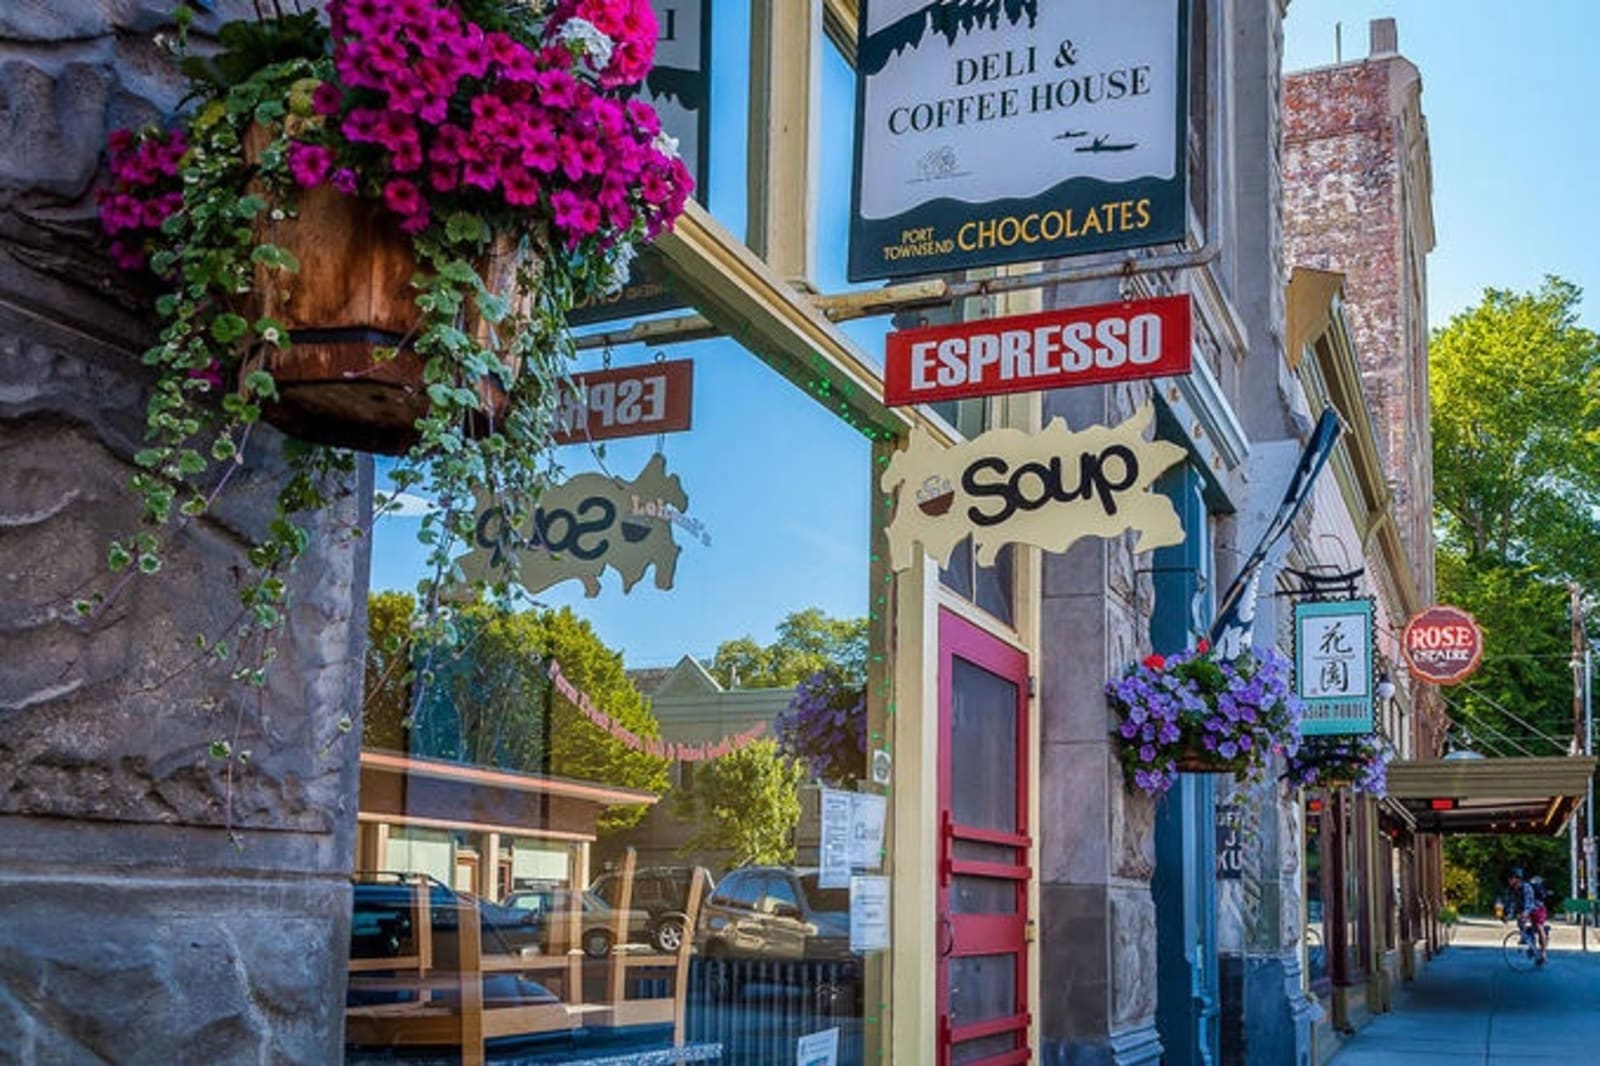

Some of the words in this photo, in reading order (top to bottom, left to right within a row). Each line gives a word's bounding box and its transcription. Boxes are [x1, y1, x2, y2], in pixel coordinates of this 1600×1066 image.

[955, 47, 1037, 86] DELI
[1054, 39, 1078, 69] &
[888, 89, 1019, 136] COFFEE
[1030, 66, 1151, 114] HOUSE
[883, 238, 954, 260] TOWNSEND
[957, 199, 1151, 252] CHOCOLATES
[902, 226, 934, 244] PORT
[910, 313, 1162, 391] ESPRESSO
[961, 444, 1139, 526] Soup
[1410, 625, 1474, 650] ROSE
